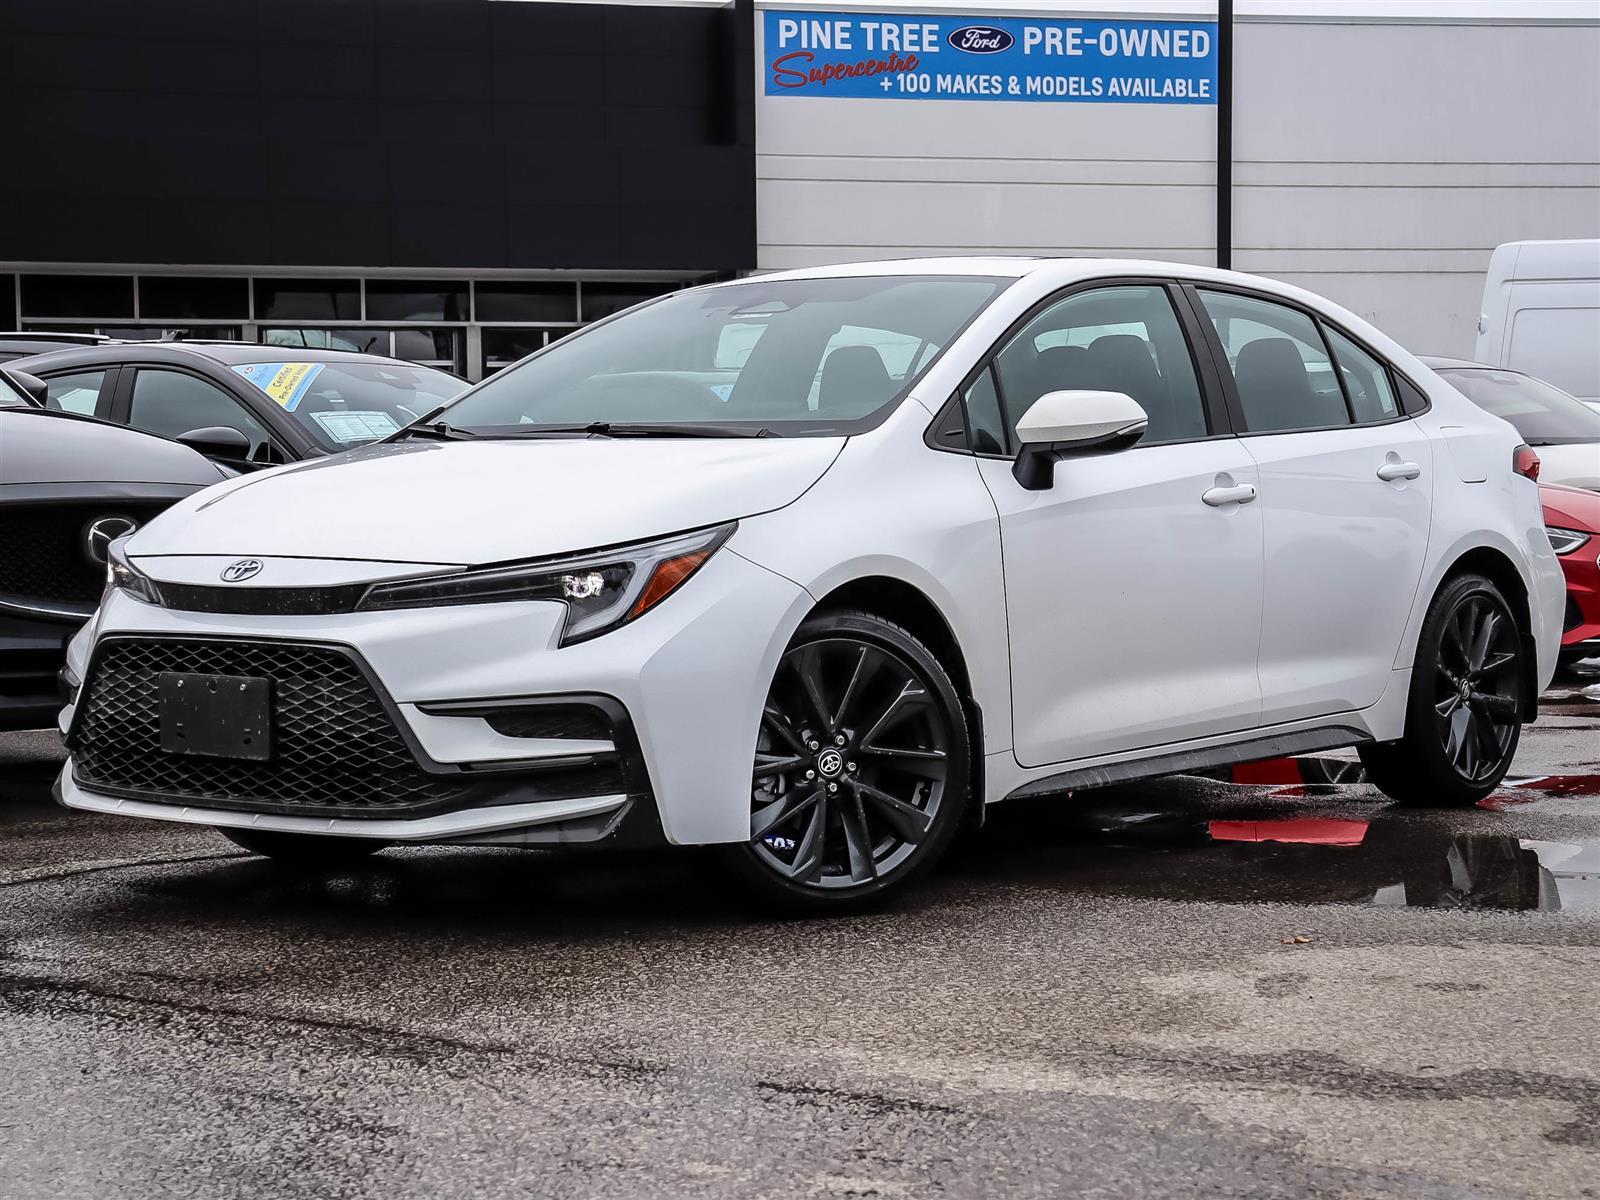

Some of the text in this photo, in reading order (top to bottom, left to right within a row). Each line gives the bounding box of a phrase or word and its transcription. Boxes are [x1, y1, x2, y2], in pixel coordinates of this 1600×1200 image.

[778, 19, 940, 52] PINE TREE
[961, 29, 1001, 49] Ford
[1023, 26, 1210, 58] PRE-OWNED
[772, 51, 920, 88] Supercentre
[936, 74, 1003, 95] MAKES
[1007, 75, 1021, 95] &
[1026, 75, 1103, 96] MODELS
[1107, 77, 1210, 98] AVAILABLE
